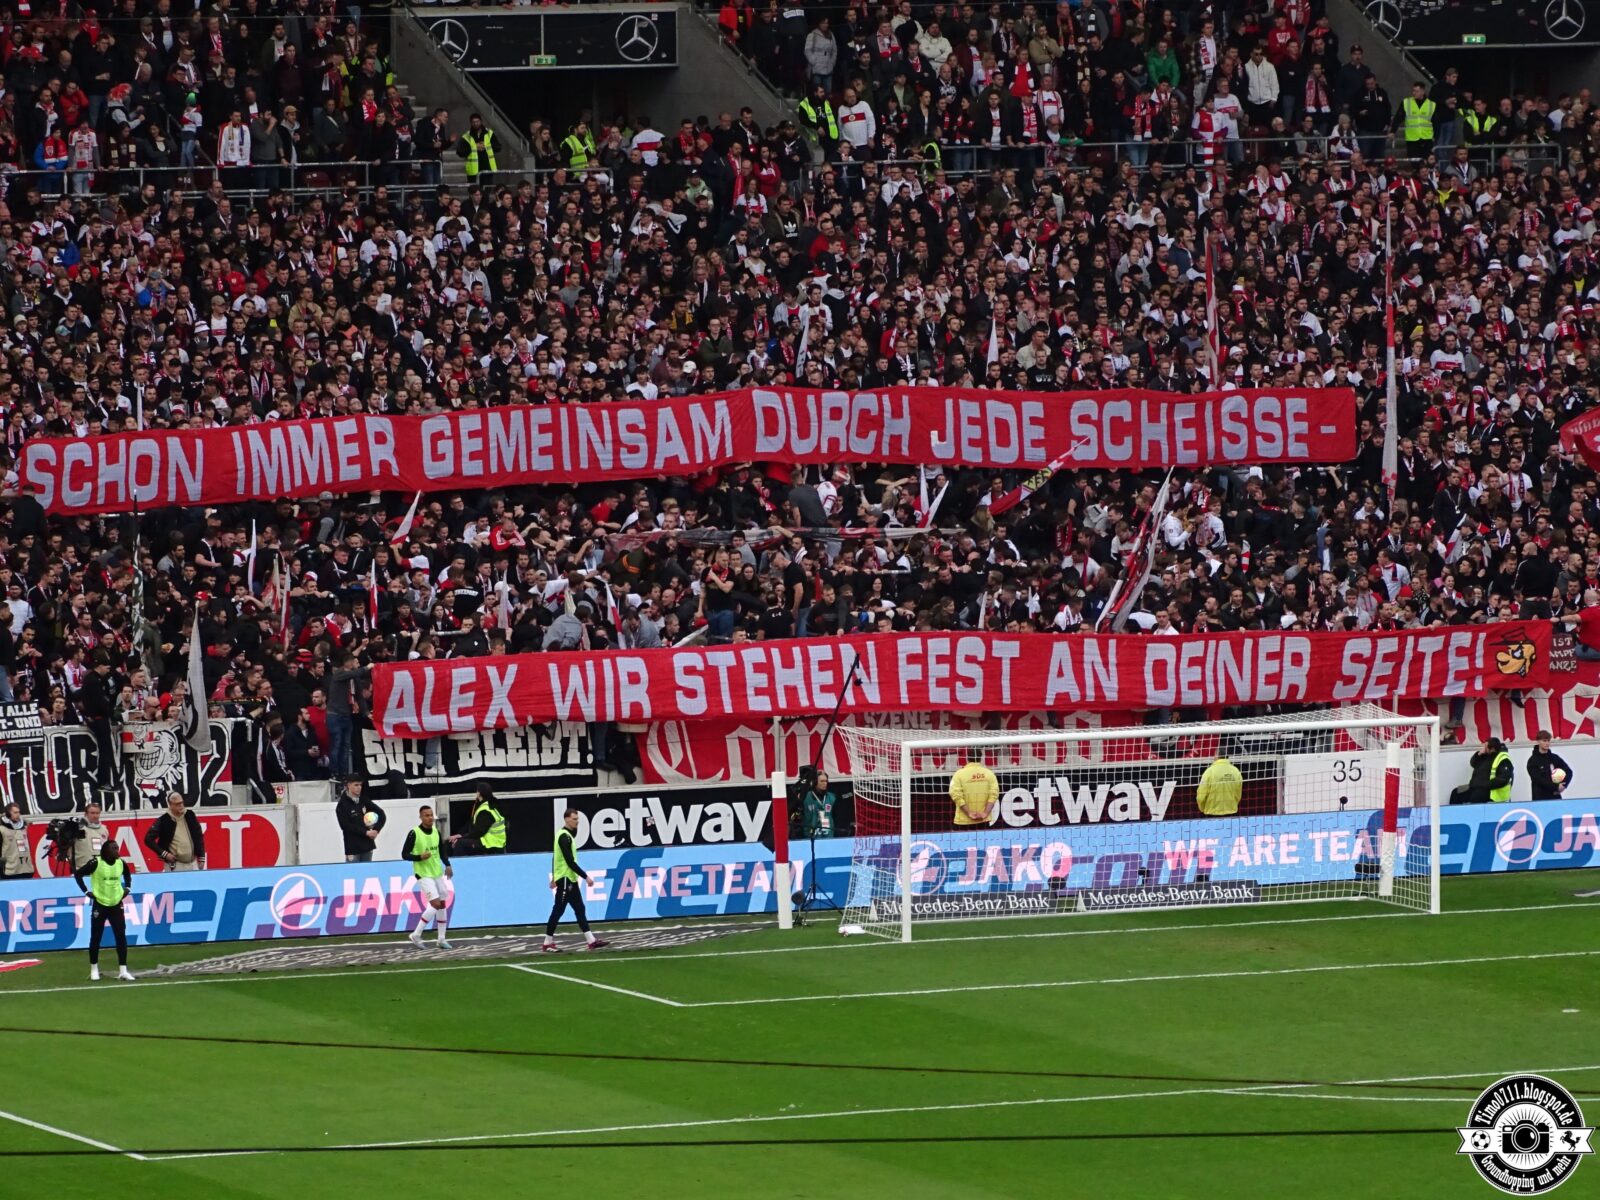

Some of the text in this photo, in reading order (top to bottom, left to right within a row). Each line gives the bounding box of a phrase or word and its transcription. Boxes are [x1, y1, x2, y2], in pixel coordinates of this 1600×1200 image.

[26, 436, 204, 508] SCHON
[231, 415, 400, 496] IMMER
[421, 398, 734, 480] GEMEINSAM
[752, 389, 911, 457] DURCH
[930, 399, 1047, 464] JEDE
[548, 657, 651, 722] WIR
[672, 641, 881, 716] STEHEN
[896, 637, 1020, 705] FEST
[1046, 638, 1119, 706] AN
[1143, 637, 1312, 706] DEINER
[1332, 632, 1488, 704] SEITE!
[6, 703, 39, 717] ALLE
[14, 715, 42, 729] UND
[863, 710, 933, 730] SZENE
[1332, 759, 1363, 783] 35
[989, 776, 1178, 828] etway
[553, 796, 773, 849] betway
[957, 841, 1074, 885] JAKO
[1163, 838, 1219, 870] WE
[1228, 833, 1300, 868] ARE
[616, 865, 693, 900] ARE
[1088, 884, 1255, 907] Mercedes-Benz Bank
[0, 892, 175, 934] RE TAM
[882, 893, 1051, 916] Mcedes-Benz Bank
